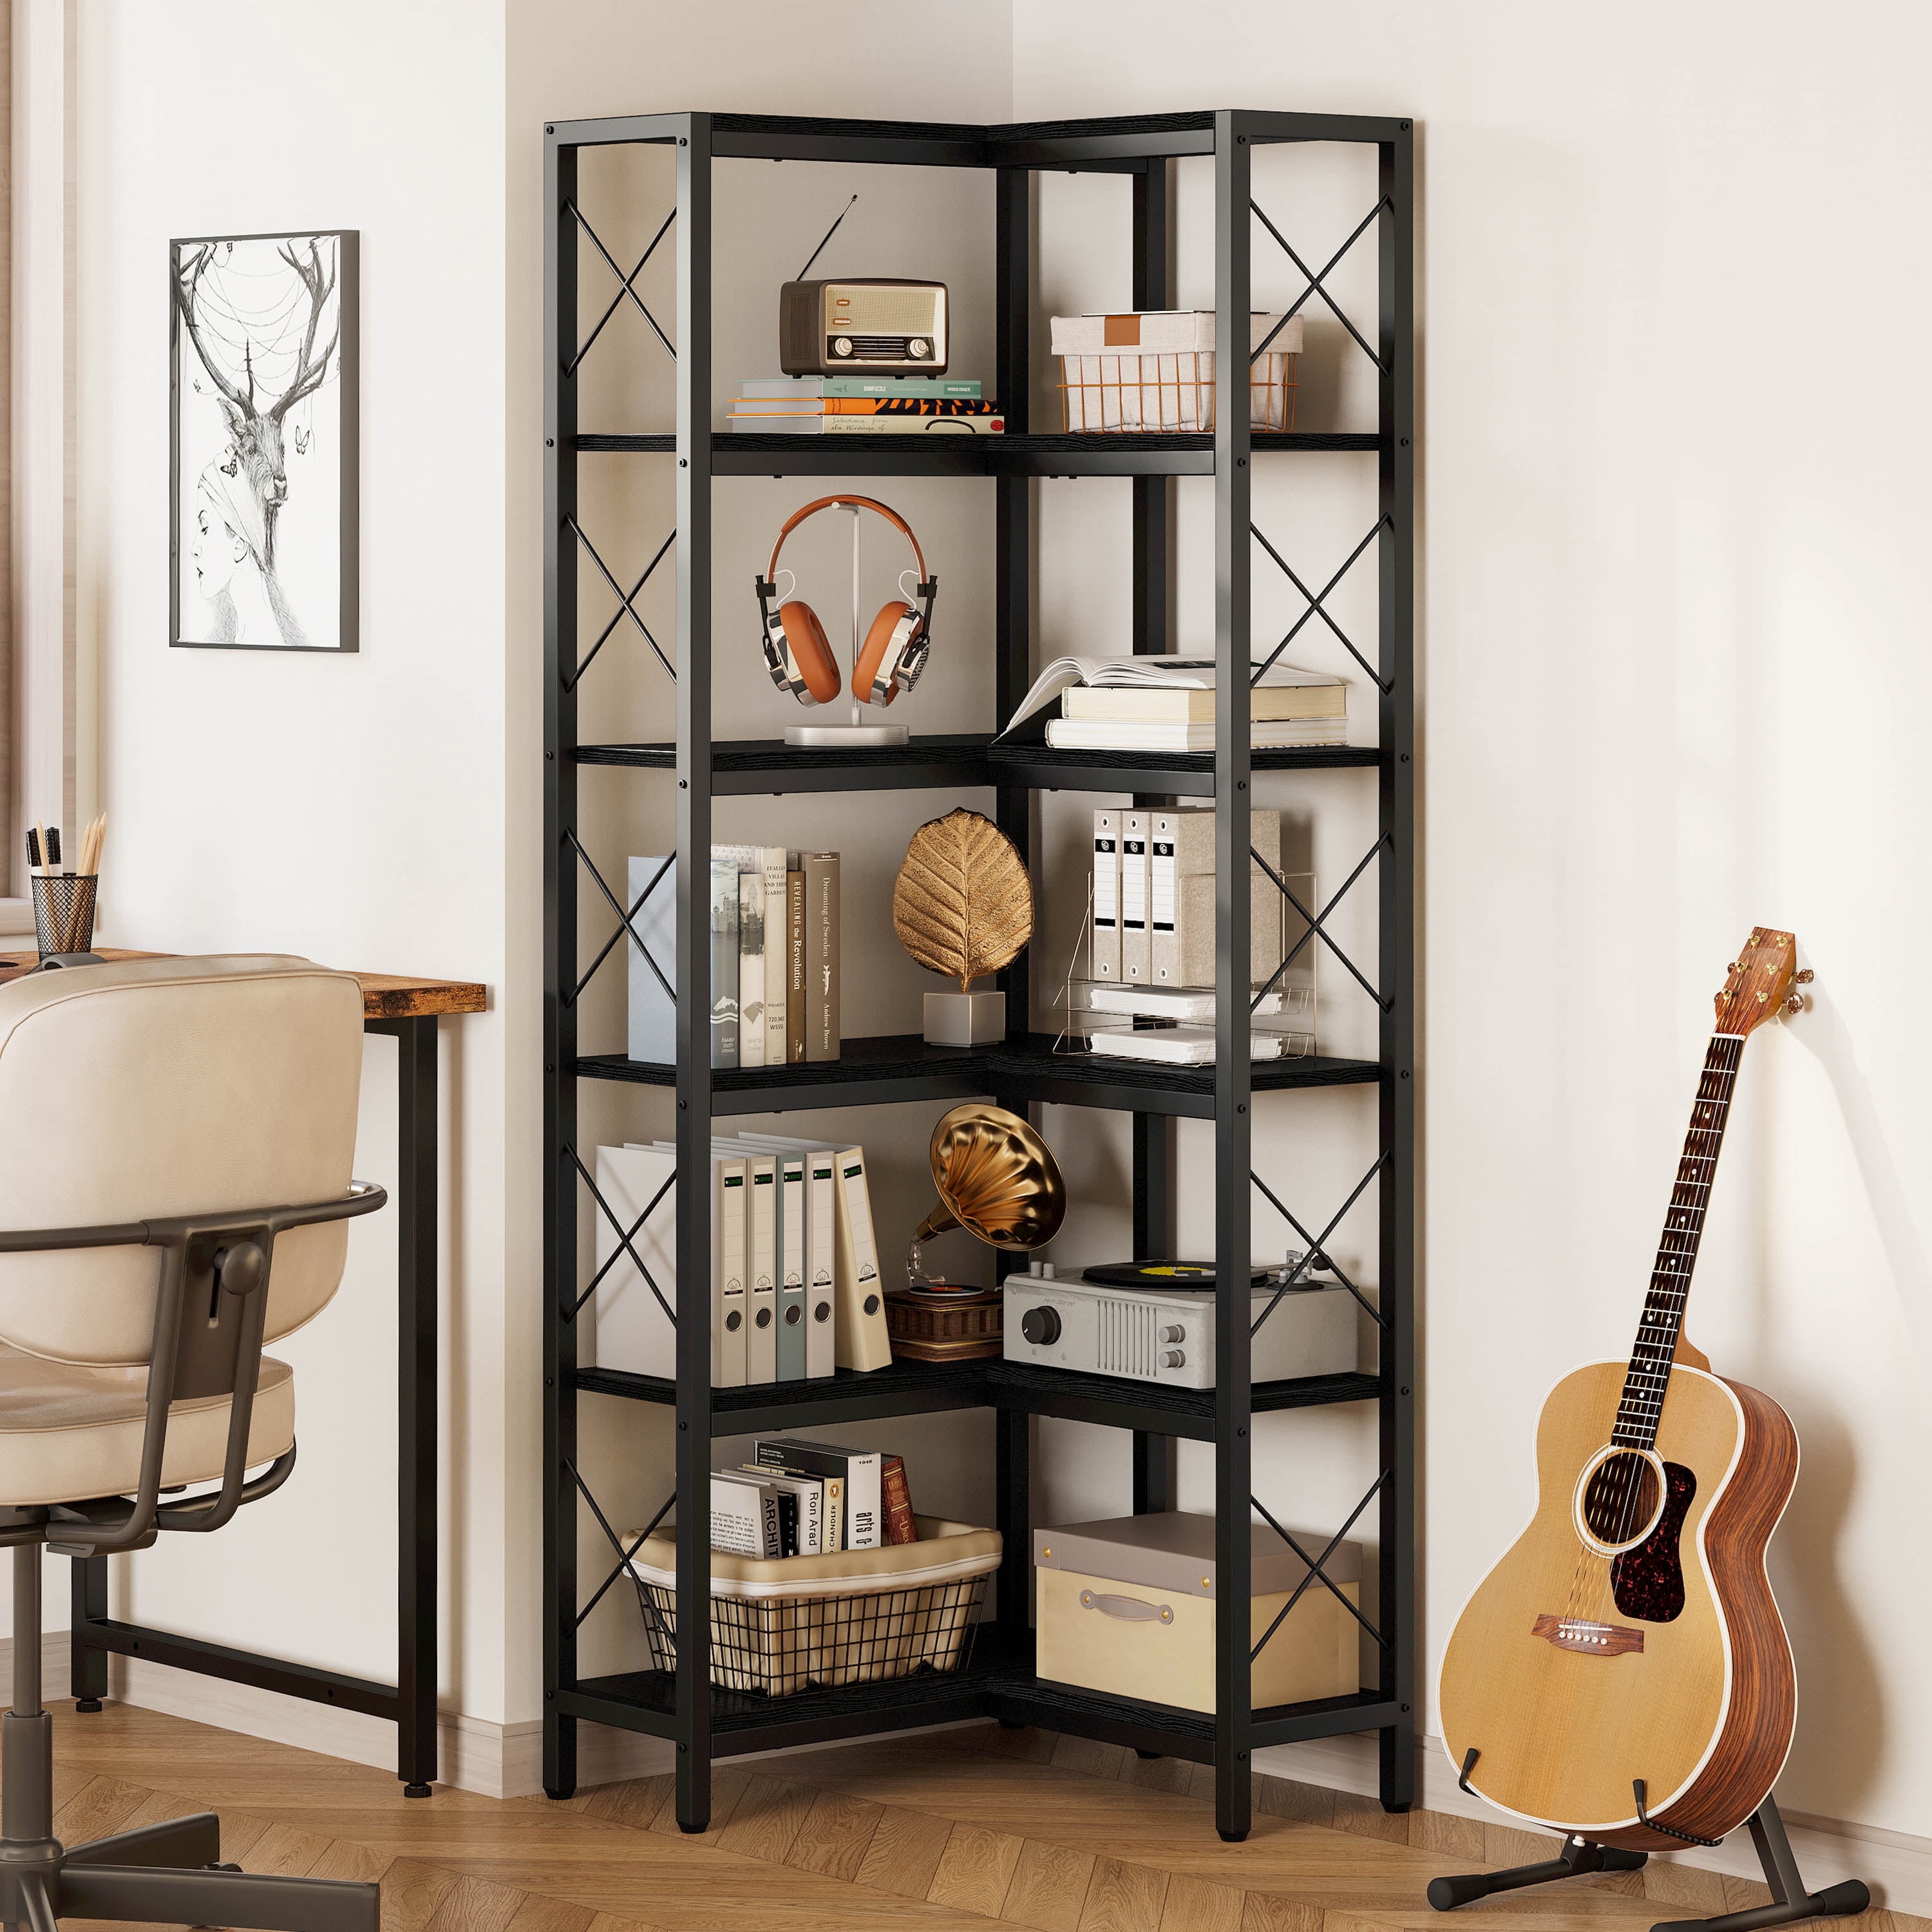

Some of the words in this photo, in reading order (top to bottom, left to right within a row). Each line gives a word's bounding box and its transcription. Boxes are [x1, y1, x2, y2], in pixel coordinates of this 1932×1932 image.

[821, 877, 830, 916] Dreaming
[823, 917, 830, 925] of
[793, 940, 802, 990] Revolution
[810, 1492, 819, 1515] Ron
[764, 1498, 779, 1558] ARCHIT
[809, 1519, 818, 1546] Arad
[856, 1511, 875, 1533] arts
